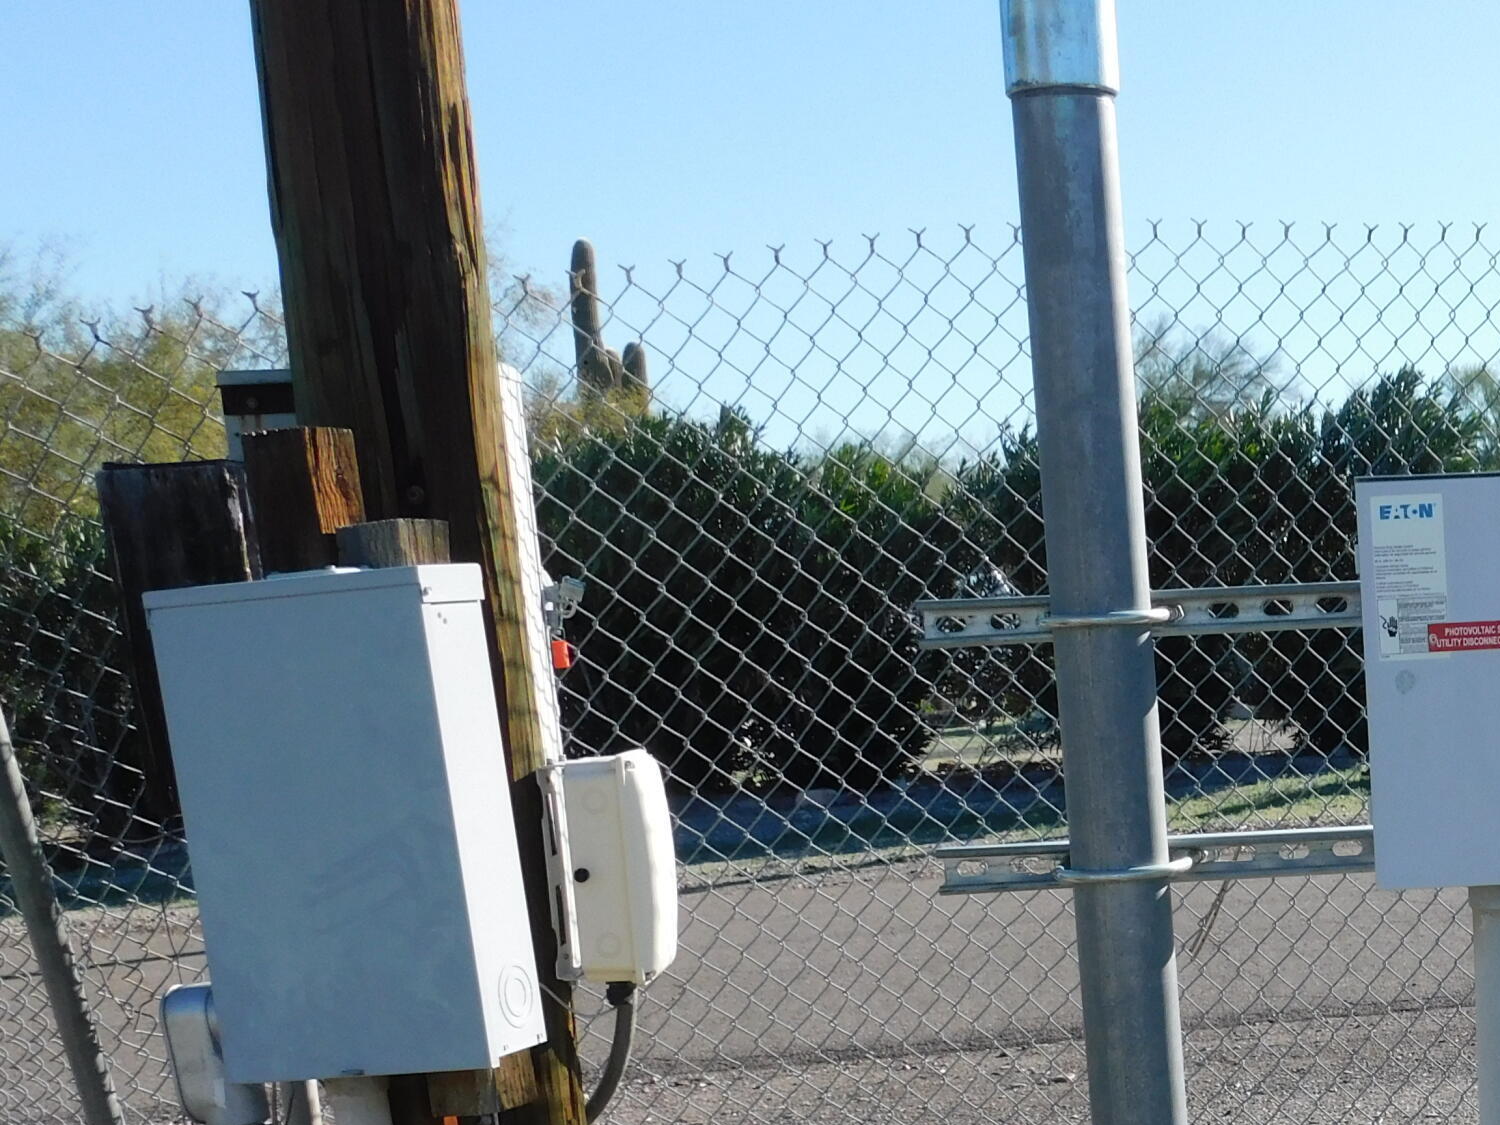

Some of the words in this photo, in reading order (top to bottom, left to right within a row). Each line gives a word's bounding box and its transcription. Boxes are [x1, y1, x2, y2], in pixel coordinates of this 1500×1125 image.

[1379, 503, 1434, 520] EATON
[1444, 625, 1497, 636] PHOTOVOLTAIC
[1436, 638, 1461, 648] UTILITY
